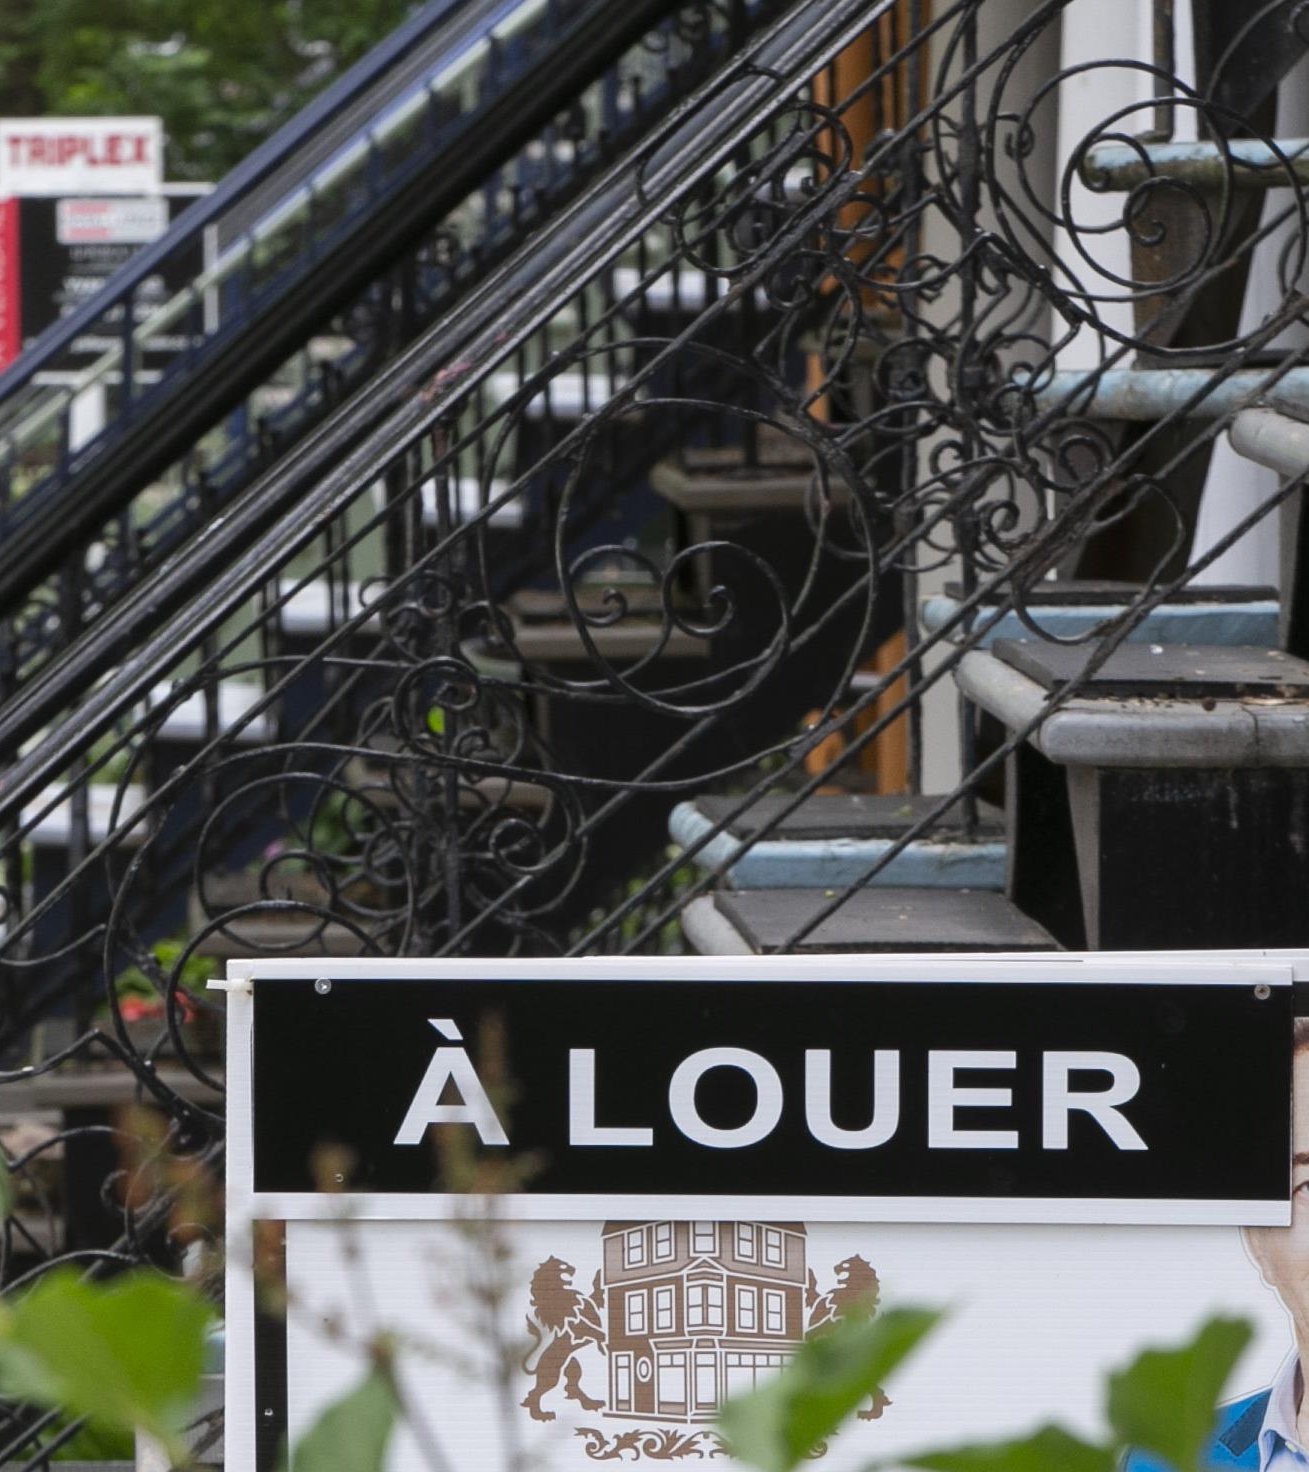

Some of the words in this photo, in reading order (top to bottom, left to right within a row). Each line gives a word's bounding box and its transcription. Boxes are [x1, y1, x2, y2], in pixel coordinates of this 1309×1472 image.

[6, 134, 152, 168] TRIPLEX
[393, 1018, 510, 1146] À
[569, 1046, 1149, 1151] LOUER
